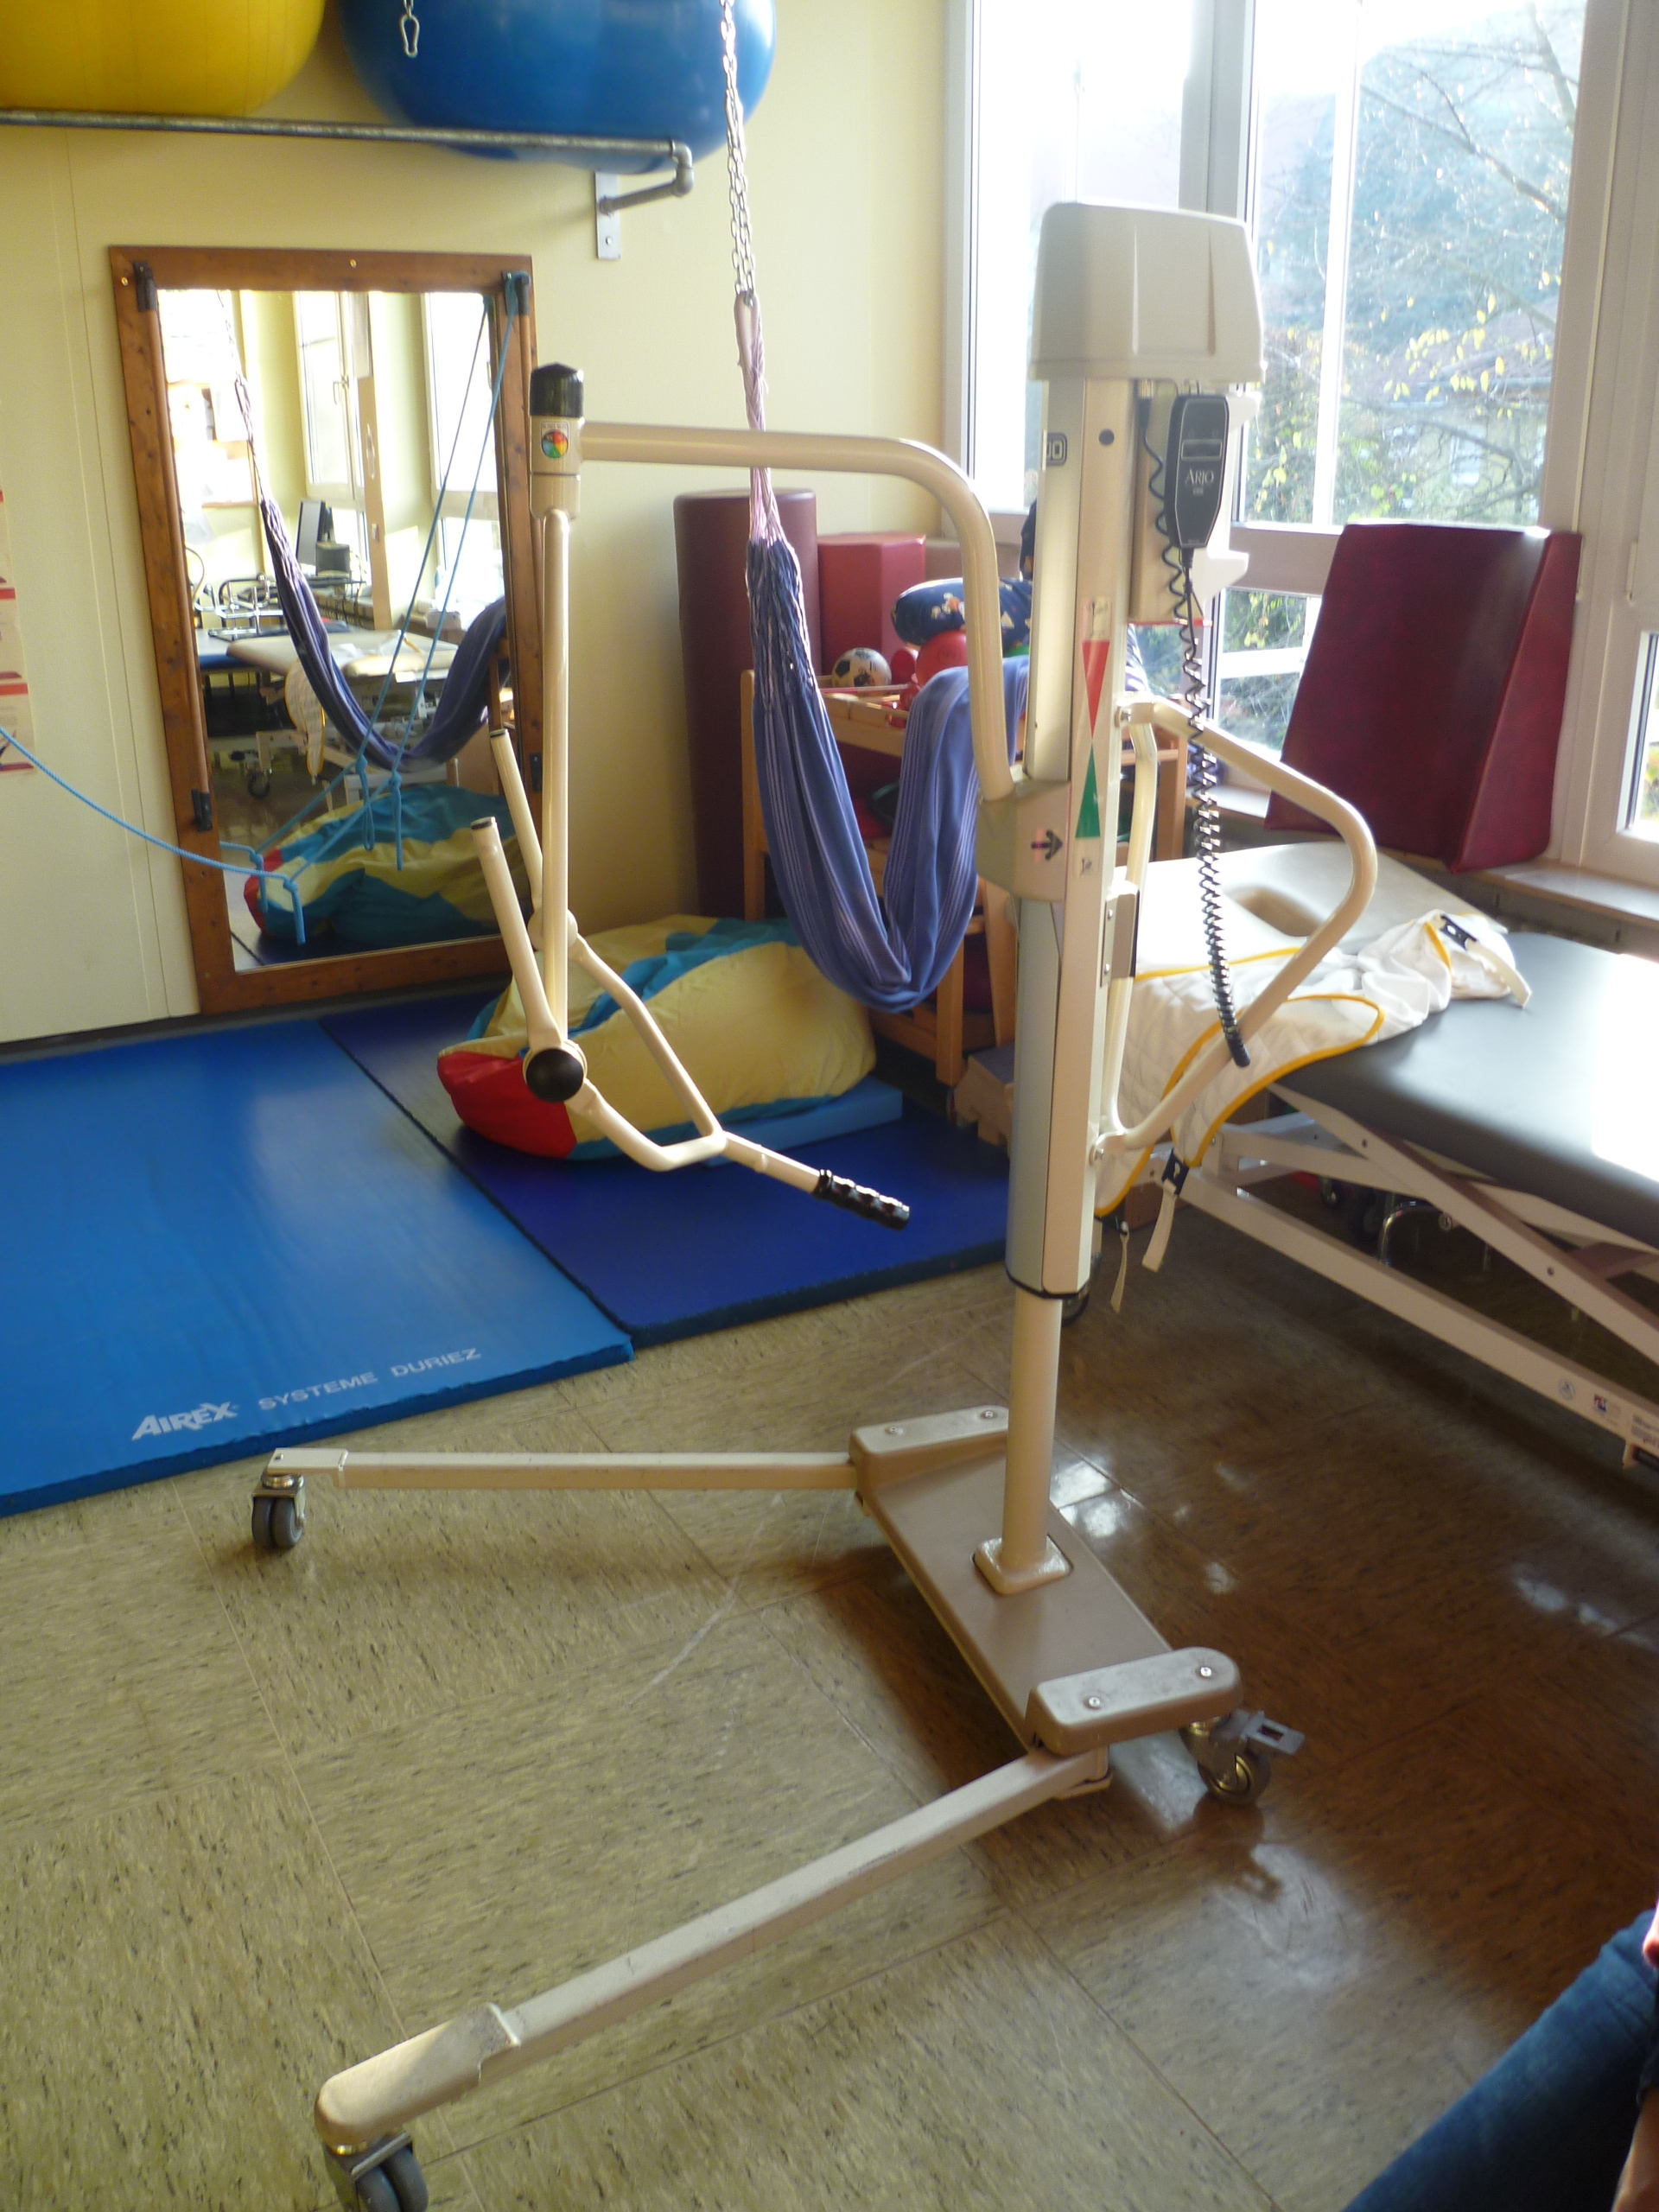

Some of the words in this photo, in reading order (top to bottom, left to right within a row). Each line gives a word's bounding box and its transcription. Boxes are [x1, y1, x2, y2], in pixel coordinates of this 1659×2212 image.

[131, 1402, 238, 1441] AIREX
[258, 1372, 378, 1410] SYSTEME
[391, 1348, 481, 1377] DURIEZ
